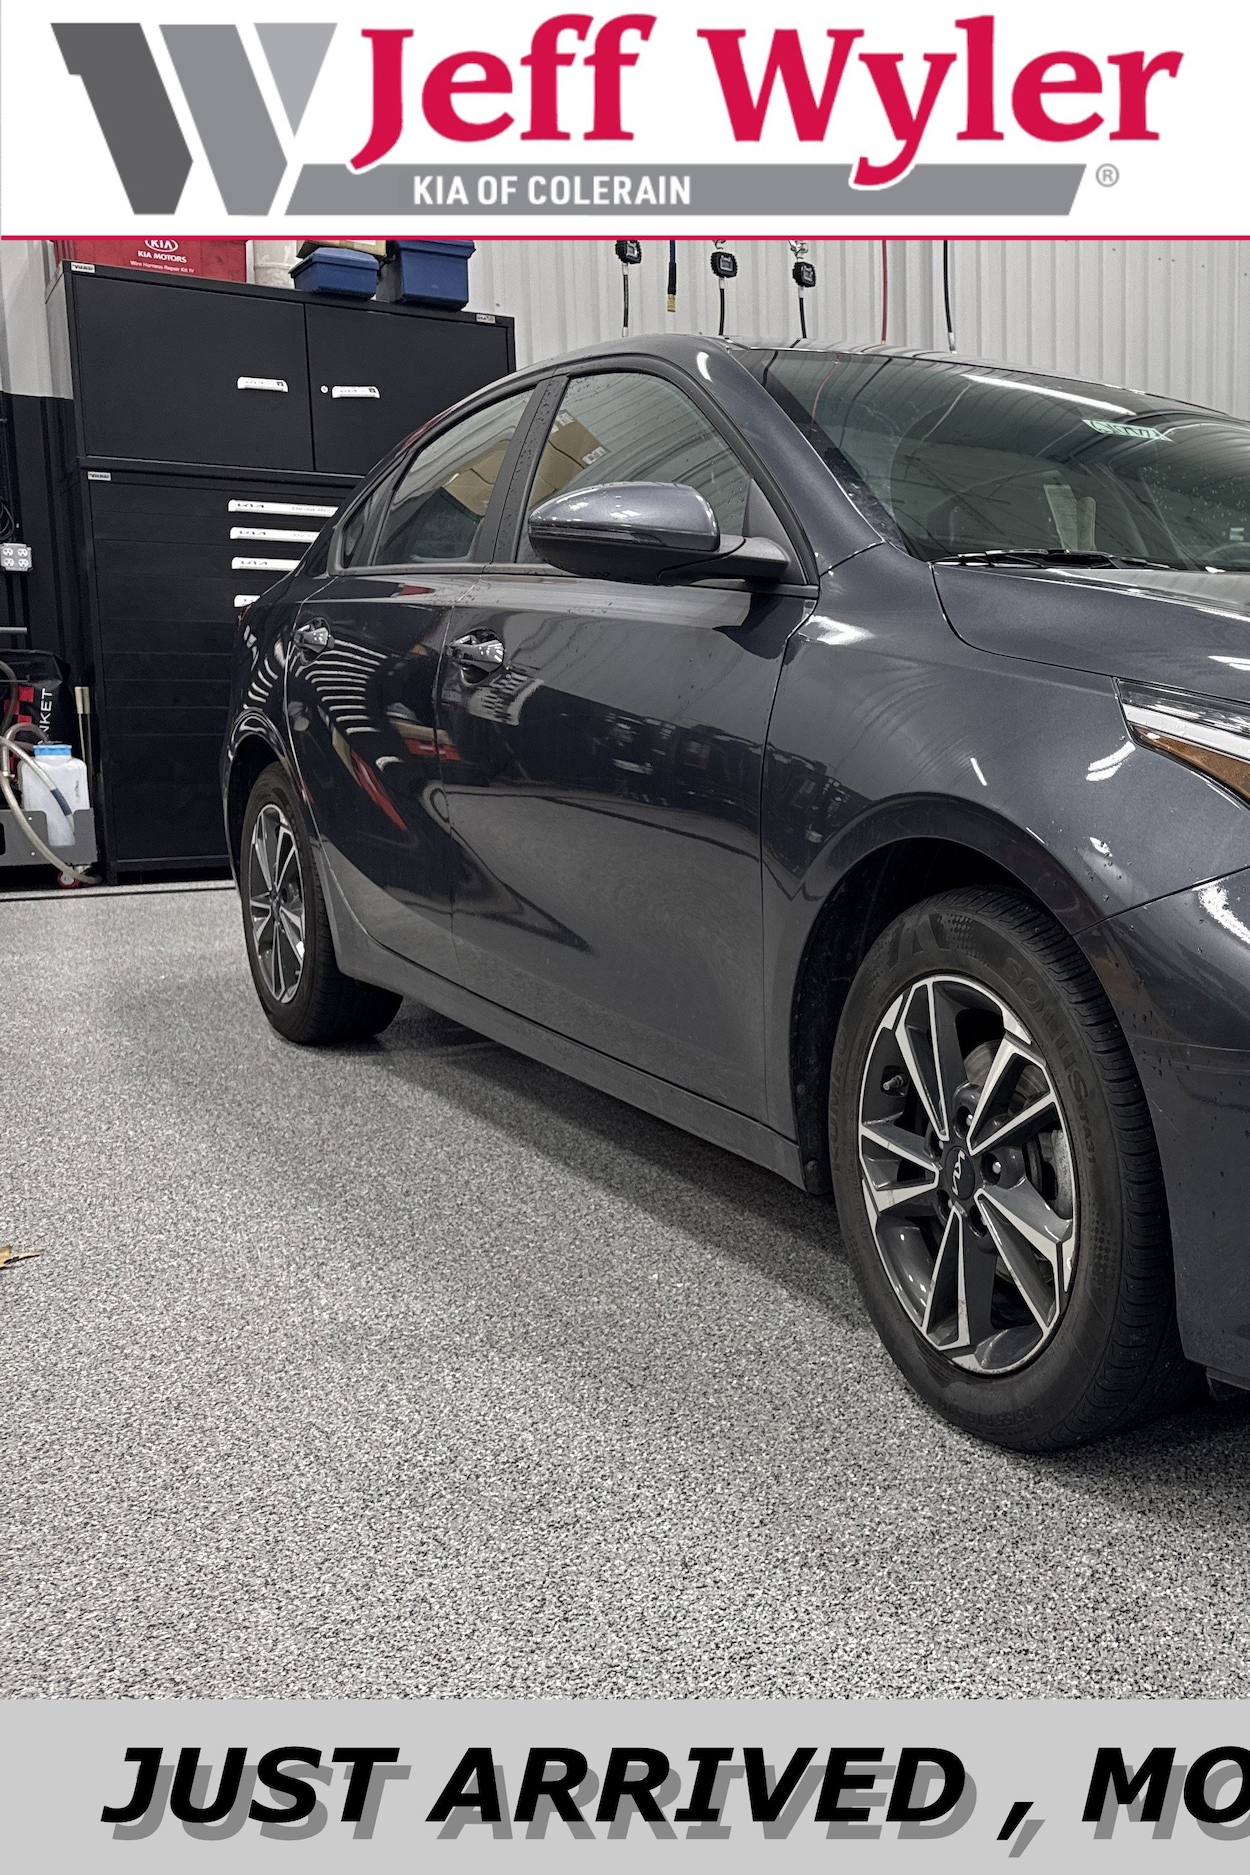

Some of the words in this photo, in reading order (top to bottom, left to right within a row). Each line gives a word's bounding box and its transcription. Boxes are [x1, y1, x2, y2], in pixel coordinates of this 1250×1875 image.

[137, 250, 152, 259] KIA
[153, 252, 187, 263] MOTORS
[142, 262, 163, 270] Harness
[163, 265, 180, 273] Repair
[1002, 956, 1090, 1103] SOLUS
